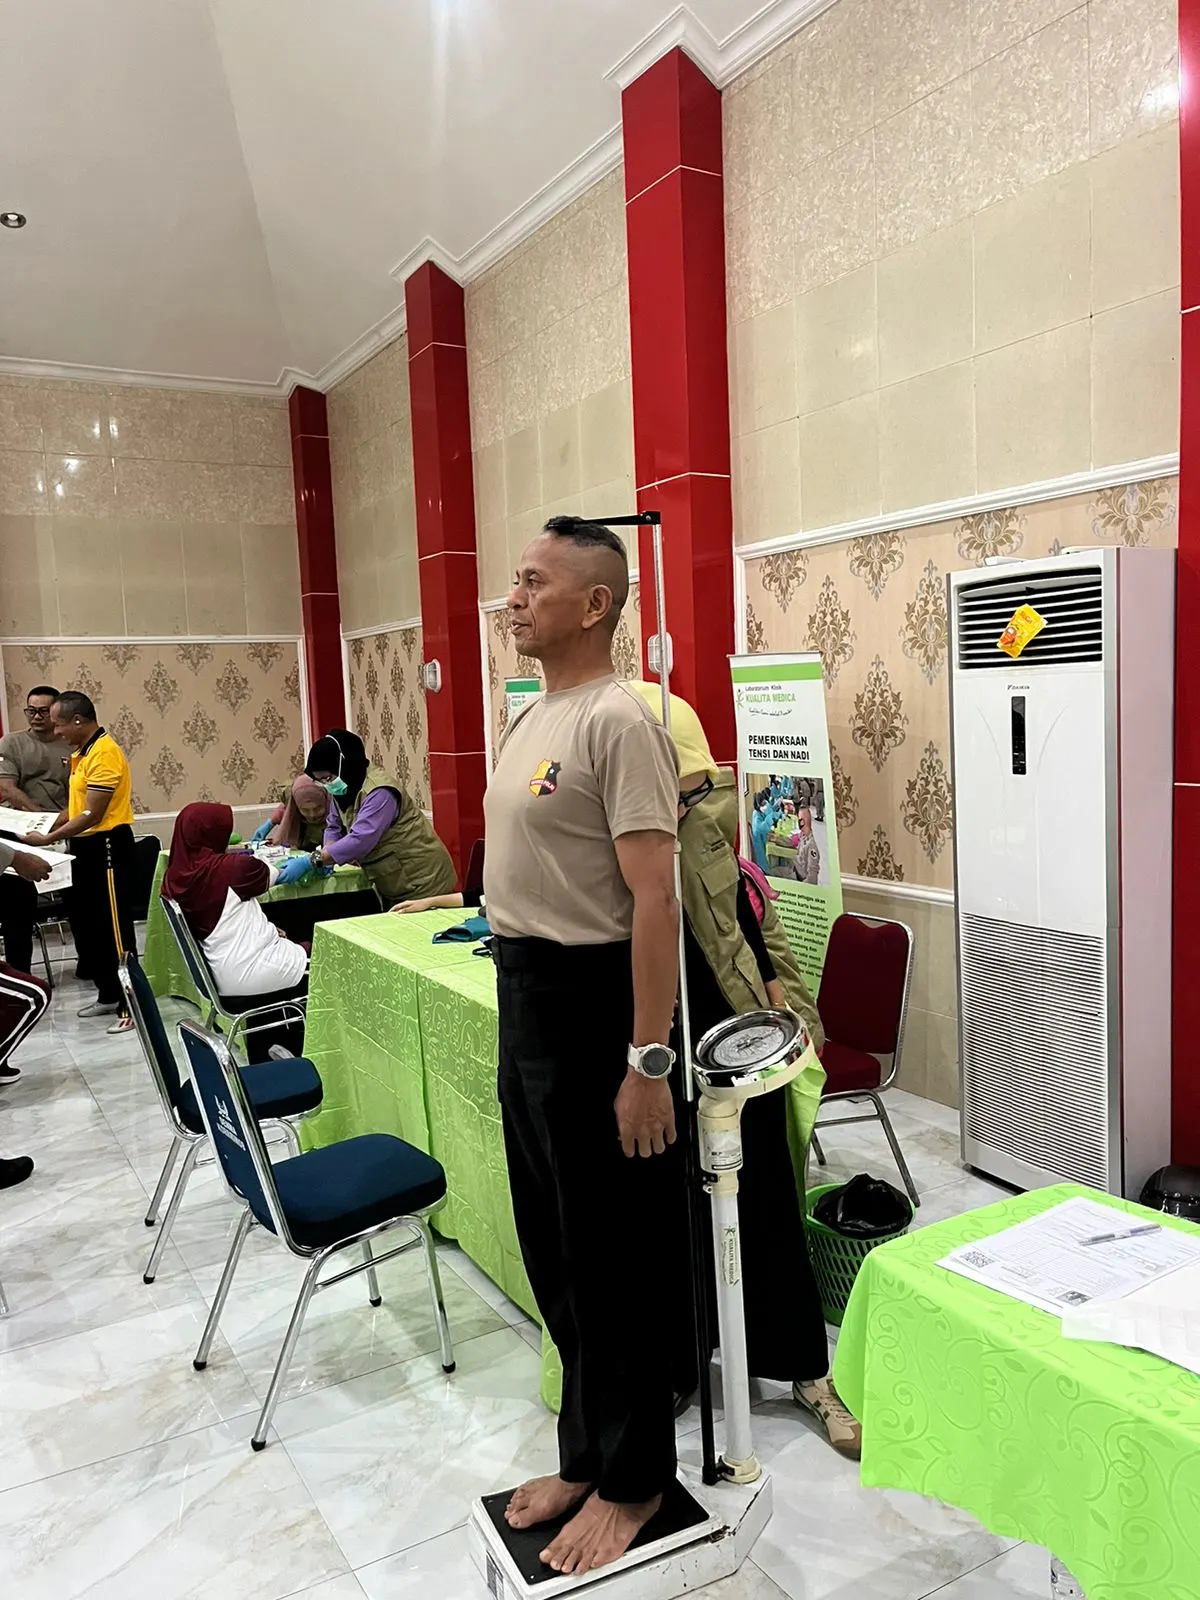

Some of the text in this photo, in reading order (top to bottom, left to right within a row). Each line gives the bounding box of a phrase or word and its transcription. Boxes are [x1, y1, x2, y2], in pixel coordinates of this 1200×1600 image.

[745, 693, 796, 703] KUALITA MEDICA
[748, 735, 808, 746] PEMERIKSAAN
[749, 749, 810, 760] TENSI DAN NADI
